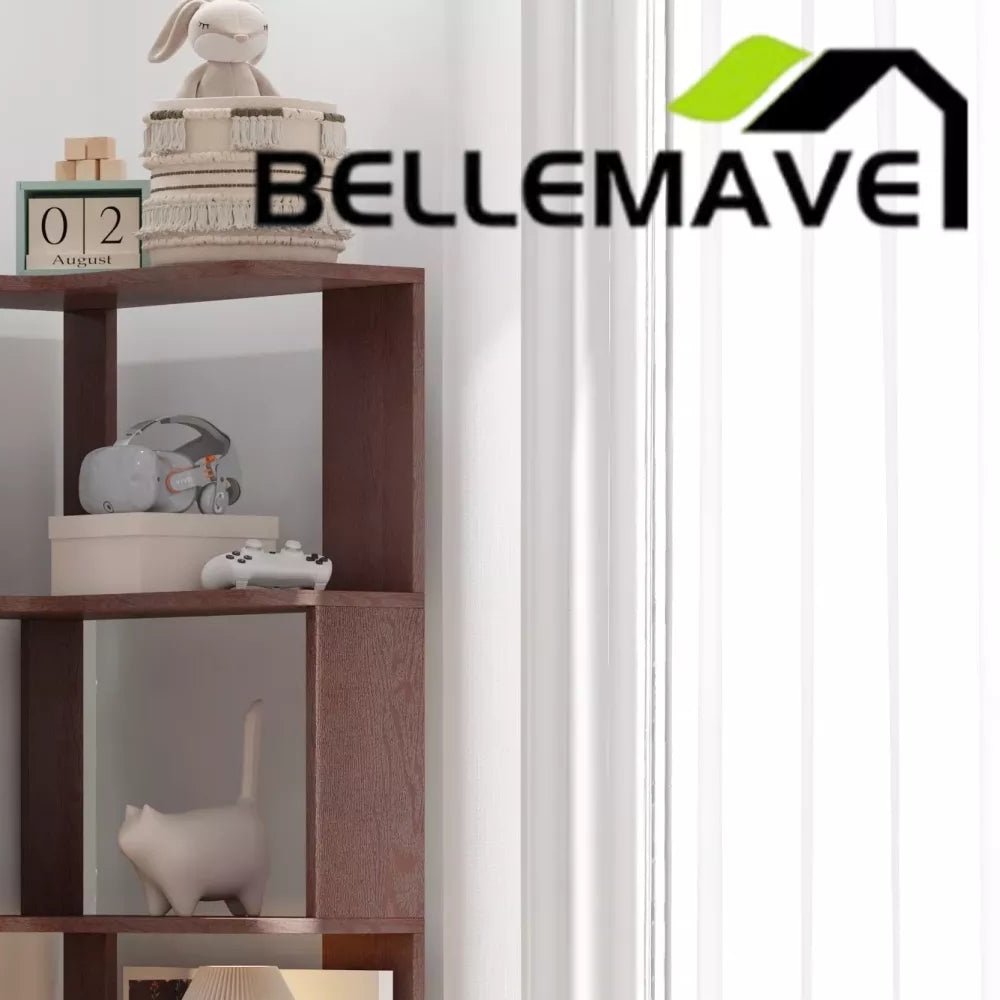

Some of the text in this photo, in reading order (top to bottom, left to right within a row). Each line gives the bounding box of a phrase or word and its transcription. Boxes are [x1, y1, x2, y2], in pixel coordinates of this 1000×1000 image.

[41, 206, 123, 245] 0 2
[52, 254, 112, 268] August
